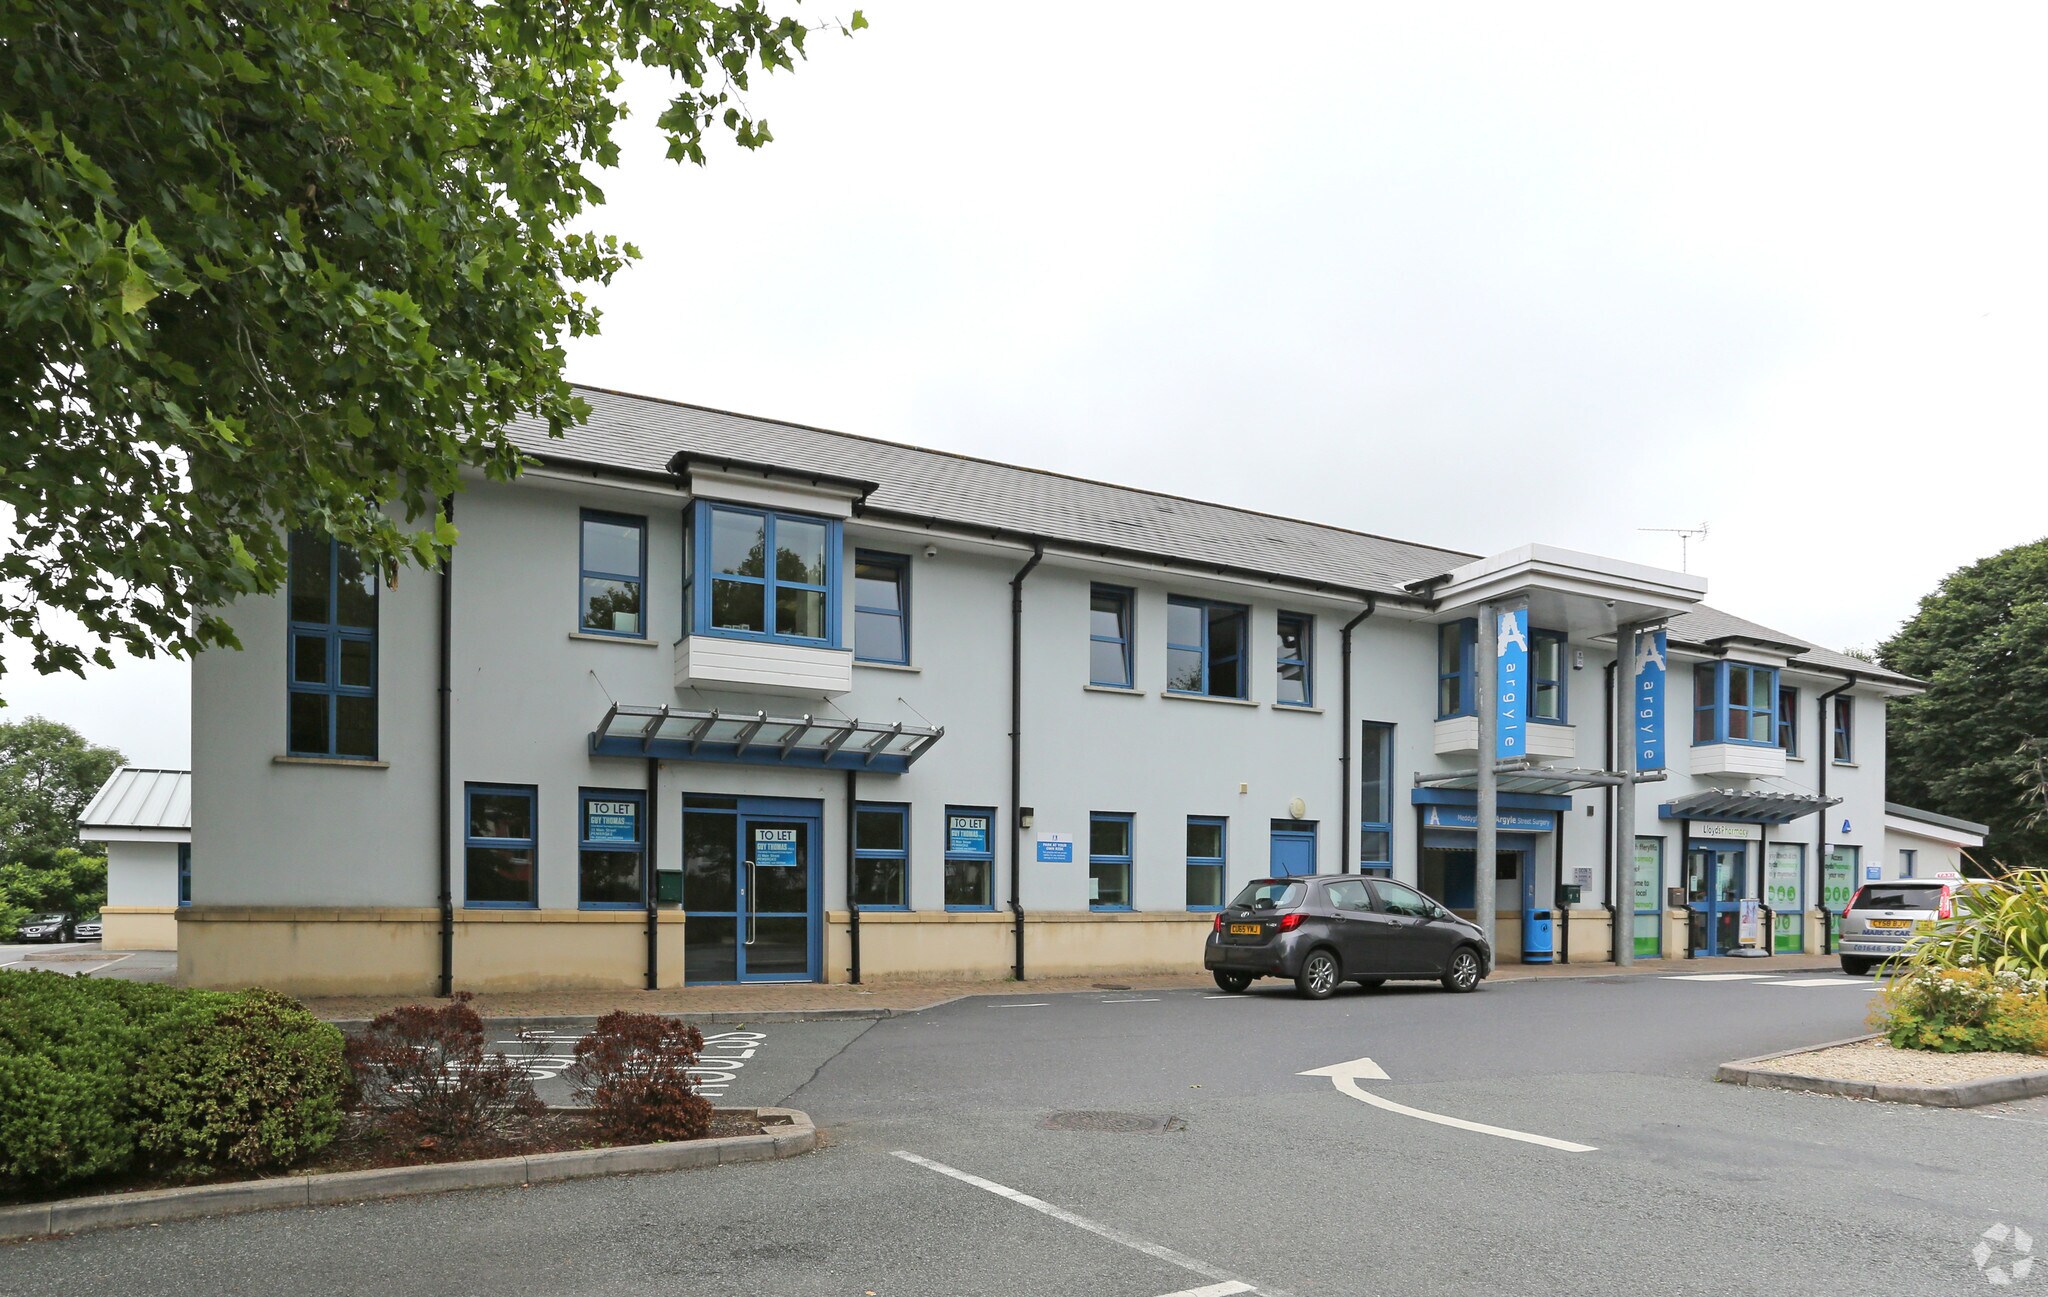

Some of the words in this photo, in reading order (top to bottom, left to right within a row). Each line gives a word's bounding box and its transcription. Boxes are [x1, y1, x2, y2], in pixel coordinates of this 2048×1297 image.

[1502, 663, 1517, 747] argyle
[1640, 681, 1657, 759] argyle
[594, 803, 609, 813] TO
[613, 804, 630, 815] LET
[591, 816, 602, 824] GUY
[602, 816, 625, 825] THOMAS
[955, 818, 967, 828] TO
[969, 819, 983, 828] LET
[1496, 816, 1517, 826] Argyle
[1517, 817, 1532, 825] Street
[1532, 818, 1551, 828] Surgery
[760, 830, 774, 841] TO
[777, 831, 792, 841] LET
[1703, 825, 1749, 838] LloydsPharmacy
[757, 843, 767, 851] GUY
[767, 843, 788, 851] THOMAS
[1861, 929, 1893, 937] MARK'S
